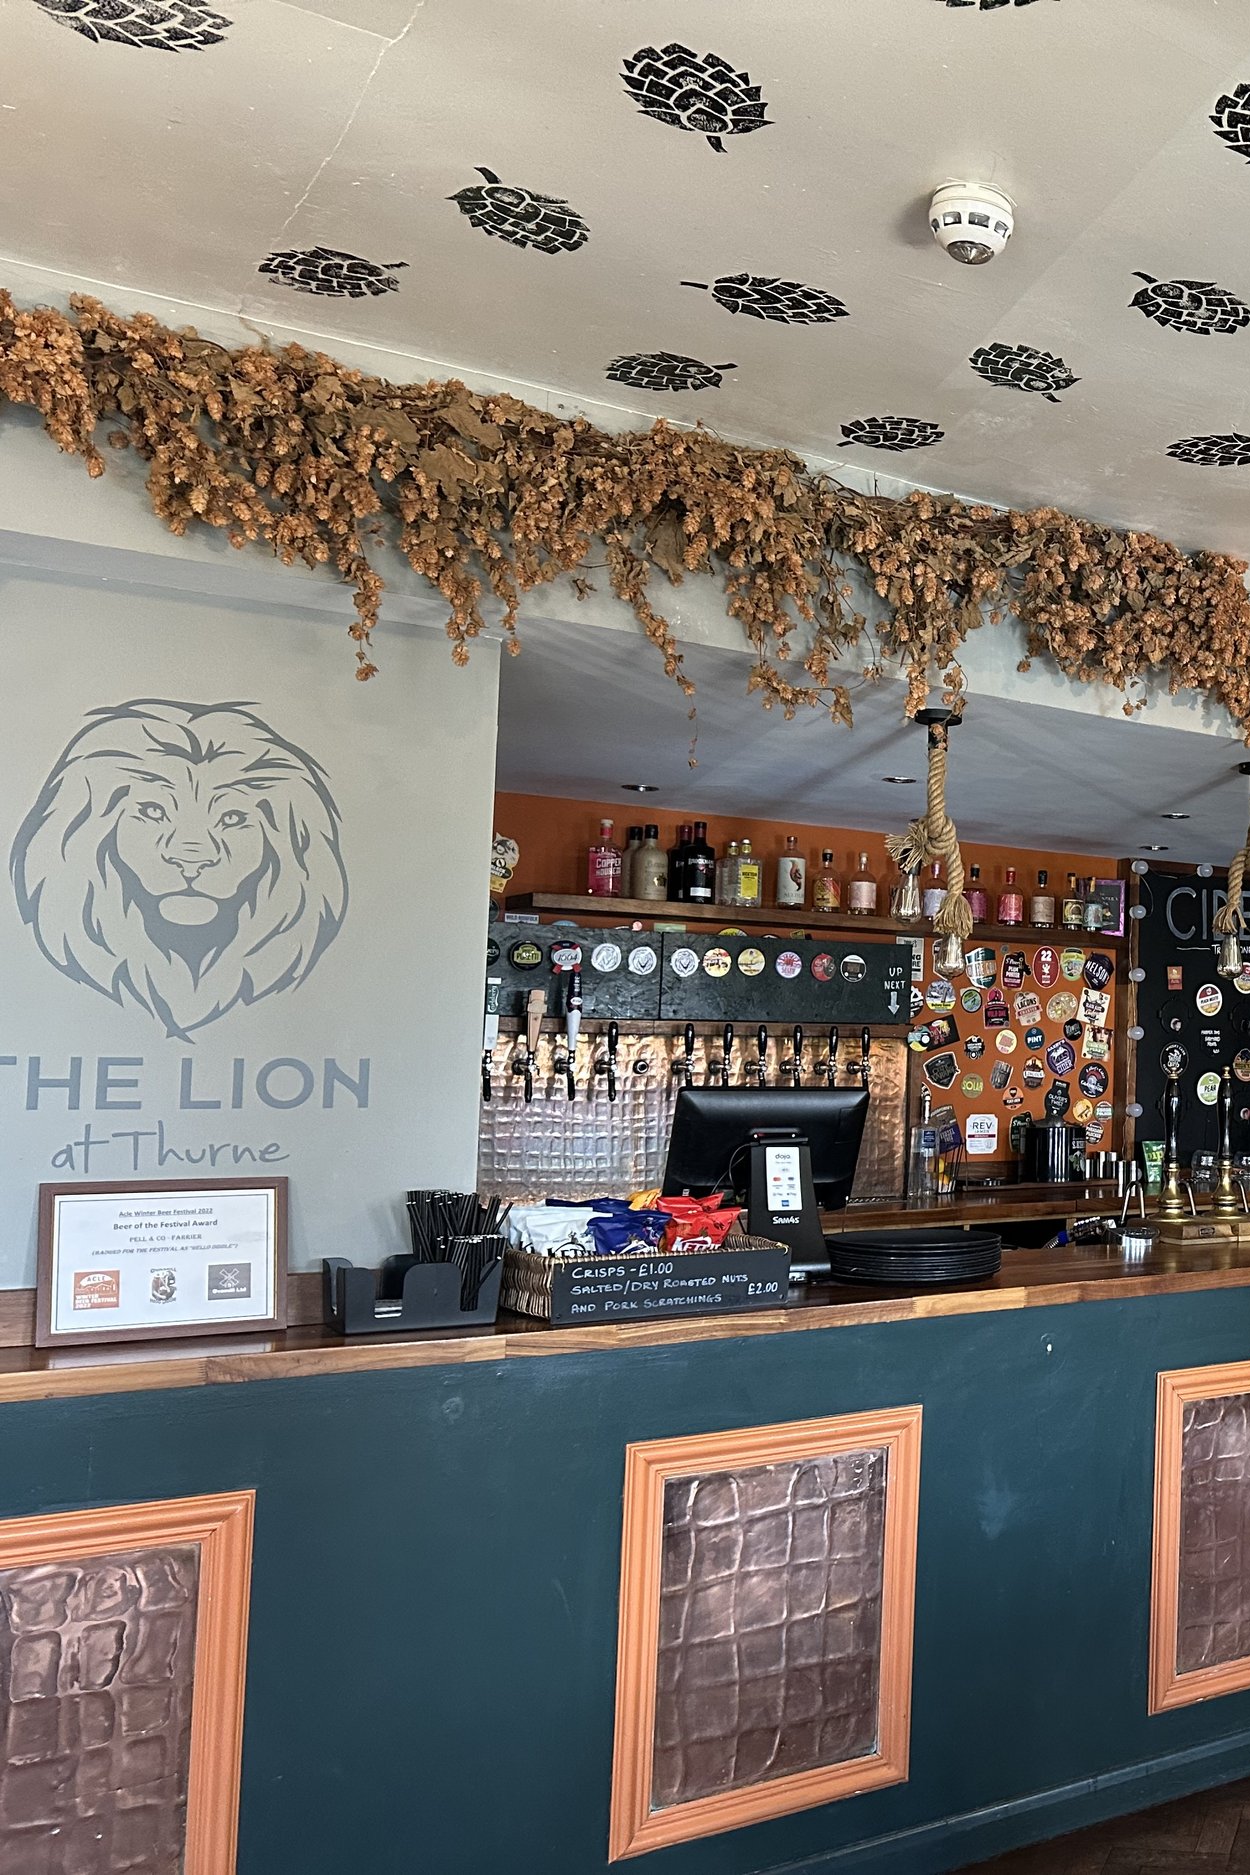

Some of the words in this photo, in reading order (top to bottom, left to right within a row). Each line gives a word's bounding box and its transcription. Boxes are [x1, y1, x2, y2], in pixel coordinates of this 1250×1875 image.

[557, 952, 578, 962] 1664
[1041, 950, 1052, 961] 22
[889, 967, 903, 978] UP
[884, 980, 906, 990] NEXT
[1027, 1035, 1042, 1044] PINT
[179, 1058, 370, 1110] LION
[1204, 1085, 1216, 1093] PEAR
[972, 1122, 993, 1130] REV
[51, 1124, 110, 1174] at
[112, 1120, 290, 1171] Thurne
[572, 1266, 625, 1279] CRISPS
[570, 1281, 659, 1295] SALTED/DRY
[663, 1277, 716, 1288] ROASTED
[722, 1274, 749, 1283] NUTS
[748, 1282, 778, 1295] £2.00
[571, 1303, 596, 1314] AND
[604, 1300, 638, 1311] PORK
[643, 1294, 722, 1309] SCRATCHINGS
